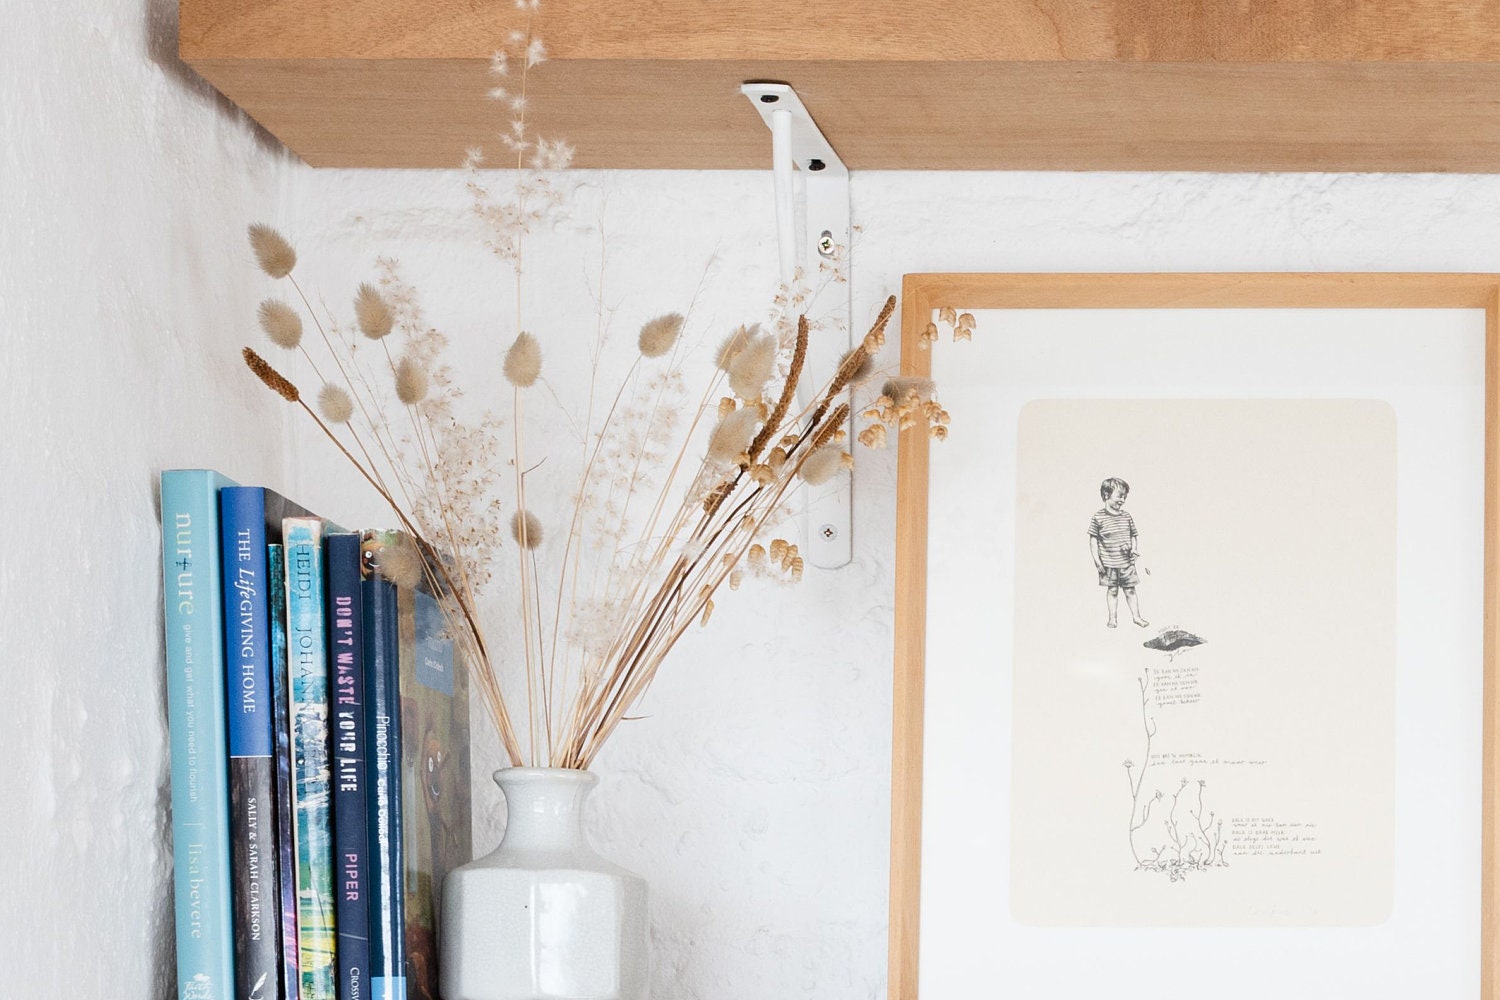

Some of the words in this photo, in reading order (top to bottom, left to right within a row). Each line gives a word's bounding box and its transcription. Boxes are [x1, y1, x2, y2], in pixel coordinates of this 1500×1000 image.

[238, 528, 251, 562] THE
[176, 511, 196, 616] nurture
[296, 543, 312, 600] HEIDI
[234, 567, 257, 658] LifeGIVING
[336, 596, 353, 646] DON'T
[183, 624, 194, 644] give
[185, 646, 196, 664] and
[183, 667, 195, 681] get
[242, 664, 256, 714] HOME
[337, 652, 356, 704] WASTE
[186, 685, 197, 707] what
[185, 710, 196, 729] you
[338, 711, 357, 752] YOUR
[187, 731, 198, 753] need
[376, 716, 391, 770] Pinocchio
[188, 756, 197, 766] to
[340, 759, 358, 792] LIFE
[188, 767, 199, 801] flourish
[247, 797, 258, 829] SALLY
[248, 831, 258, 840] &
[188, 843, 203, 874] lisa
[249, 843, 259, 879] SARAH
[345, 853, 359, 901] PIPER
[190, 879, 204, 939] bevere
[250, 882, 261, 941] CLARKSON
